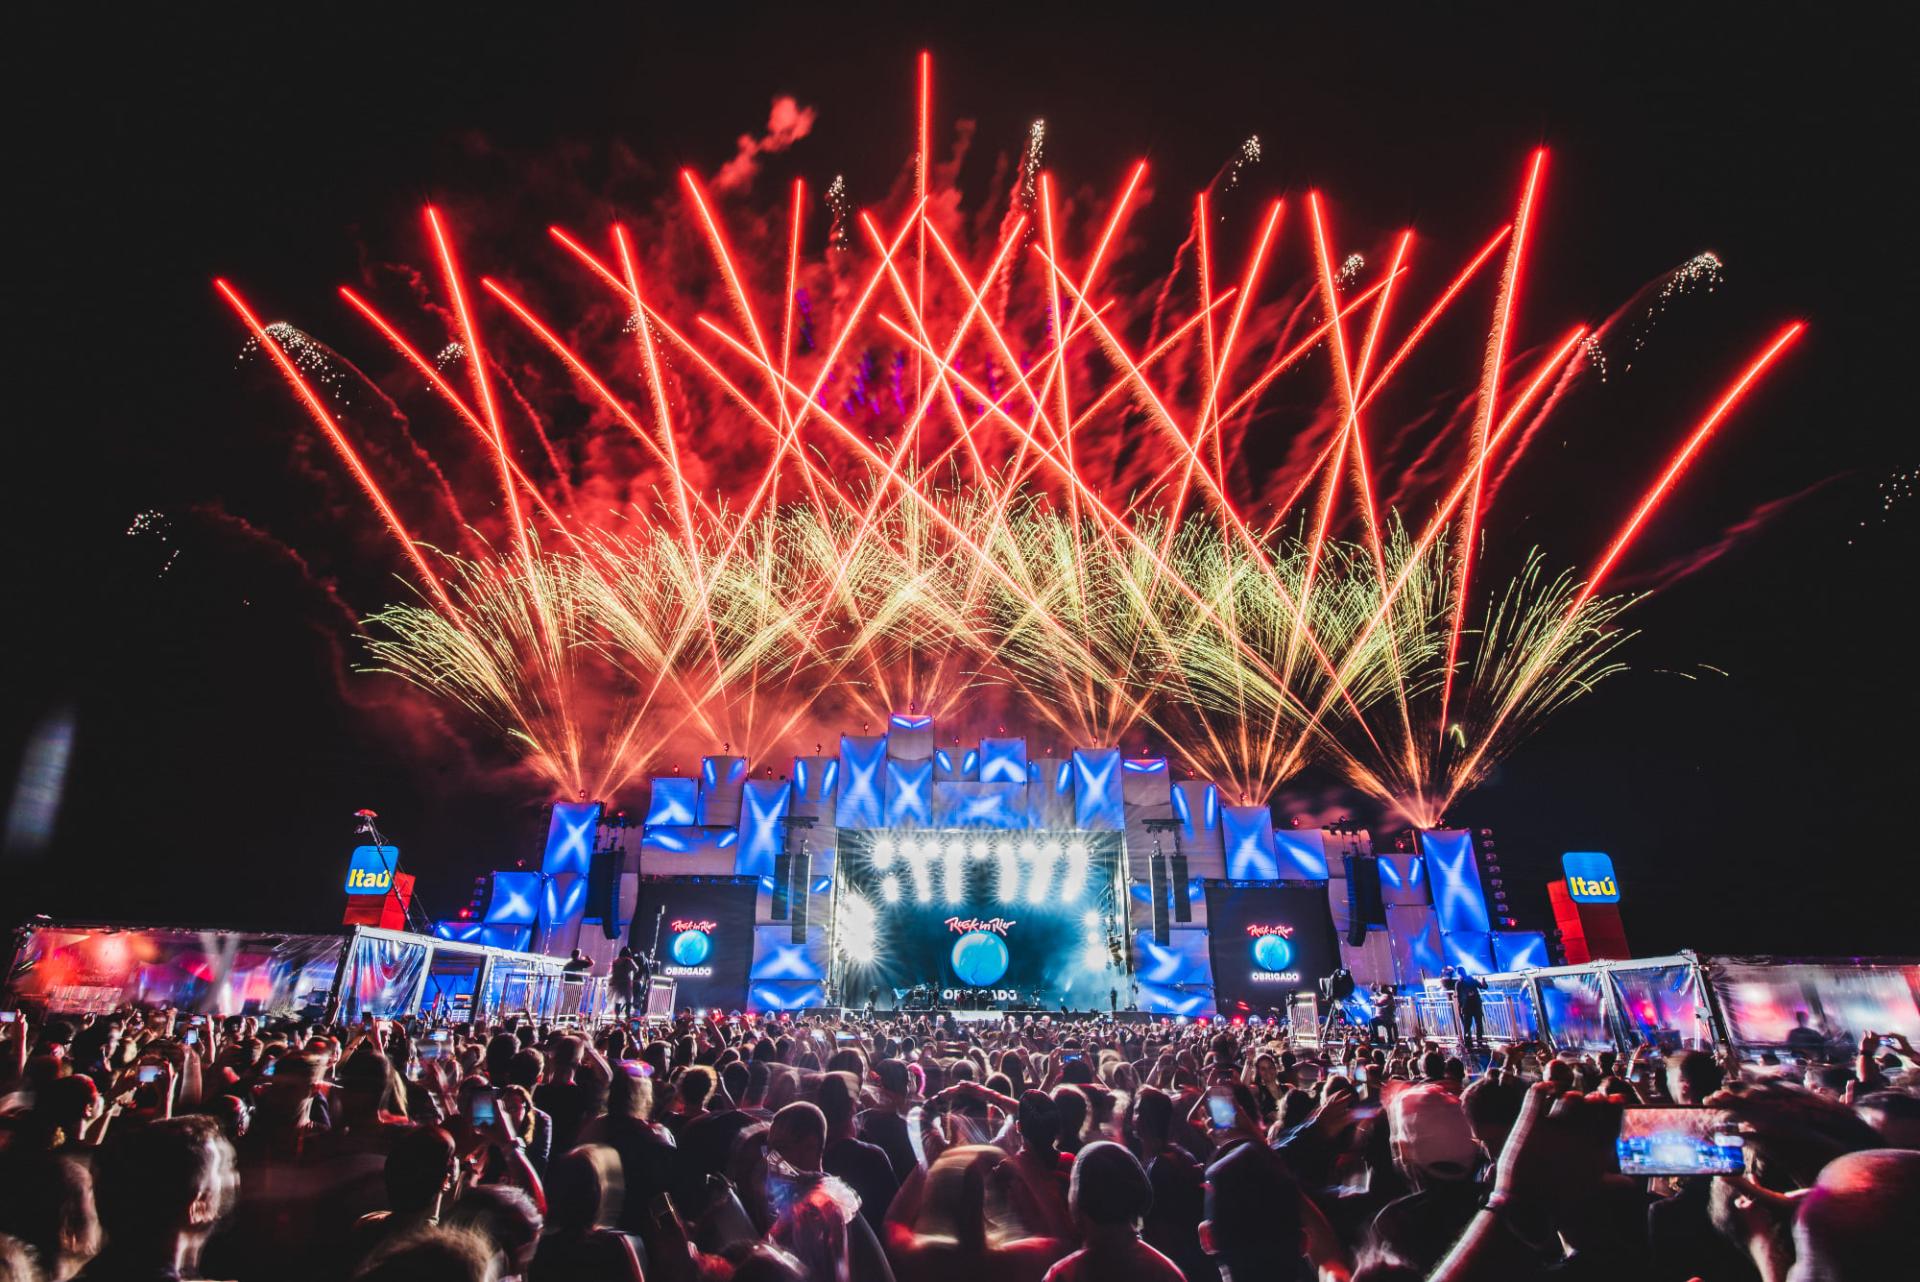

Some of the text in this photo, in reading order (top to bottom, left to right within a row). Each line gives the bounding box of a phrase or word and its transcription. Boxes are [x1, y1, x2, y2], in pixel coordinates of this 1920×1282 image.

[348, 869, 391, 888] Itaú
[1570, 876, 1617, 896] Itaú
[944, 917, 1017, 936] Rock in Rio
[665, 967, 712, 976] OBRIGADO
[1251, 972, 1300, 981] OBRIGADO
[943, 989, 1018, 1001] OADO
